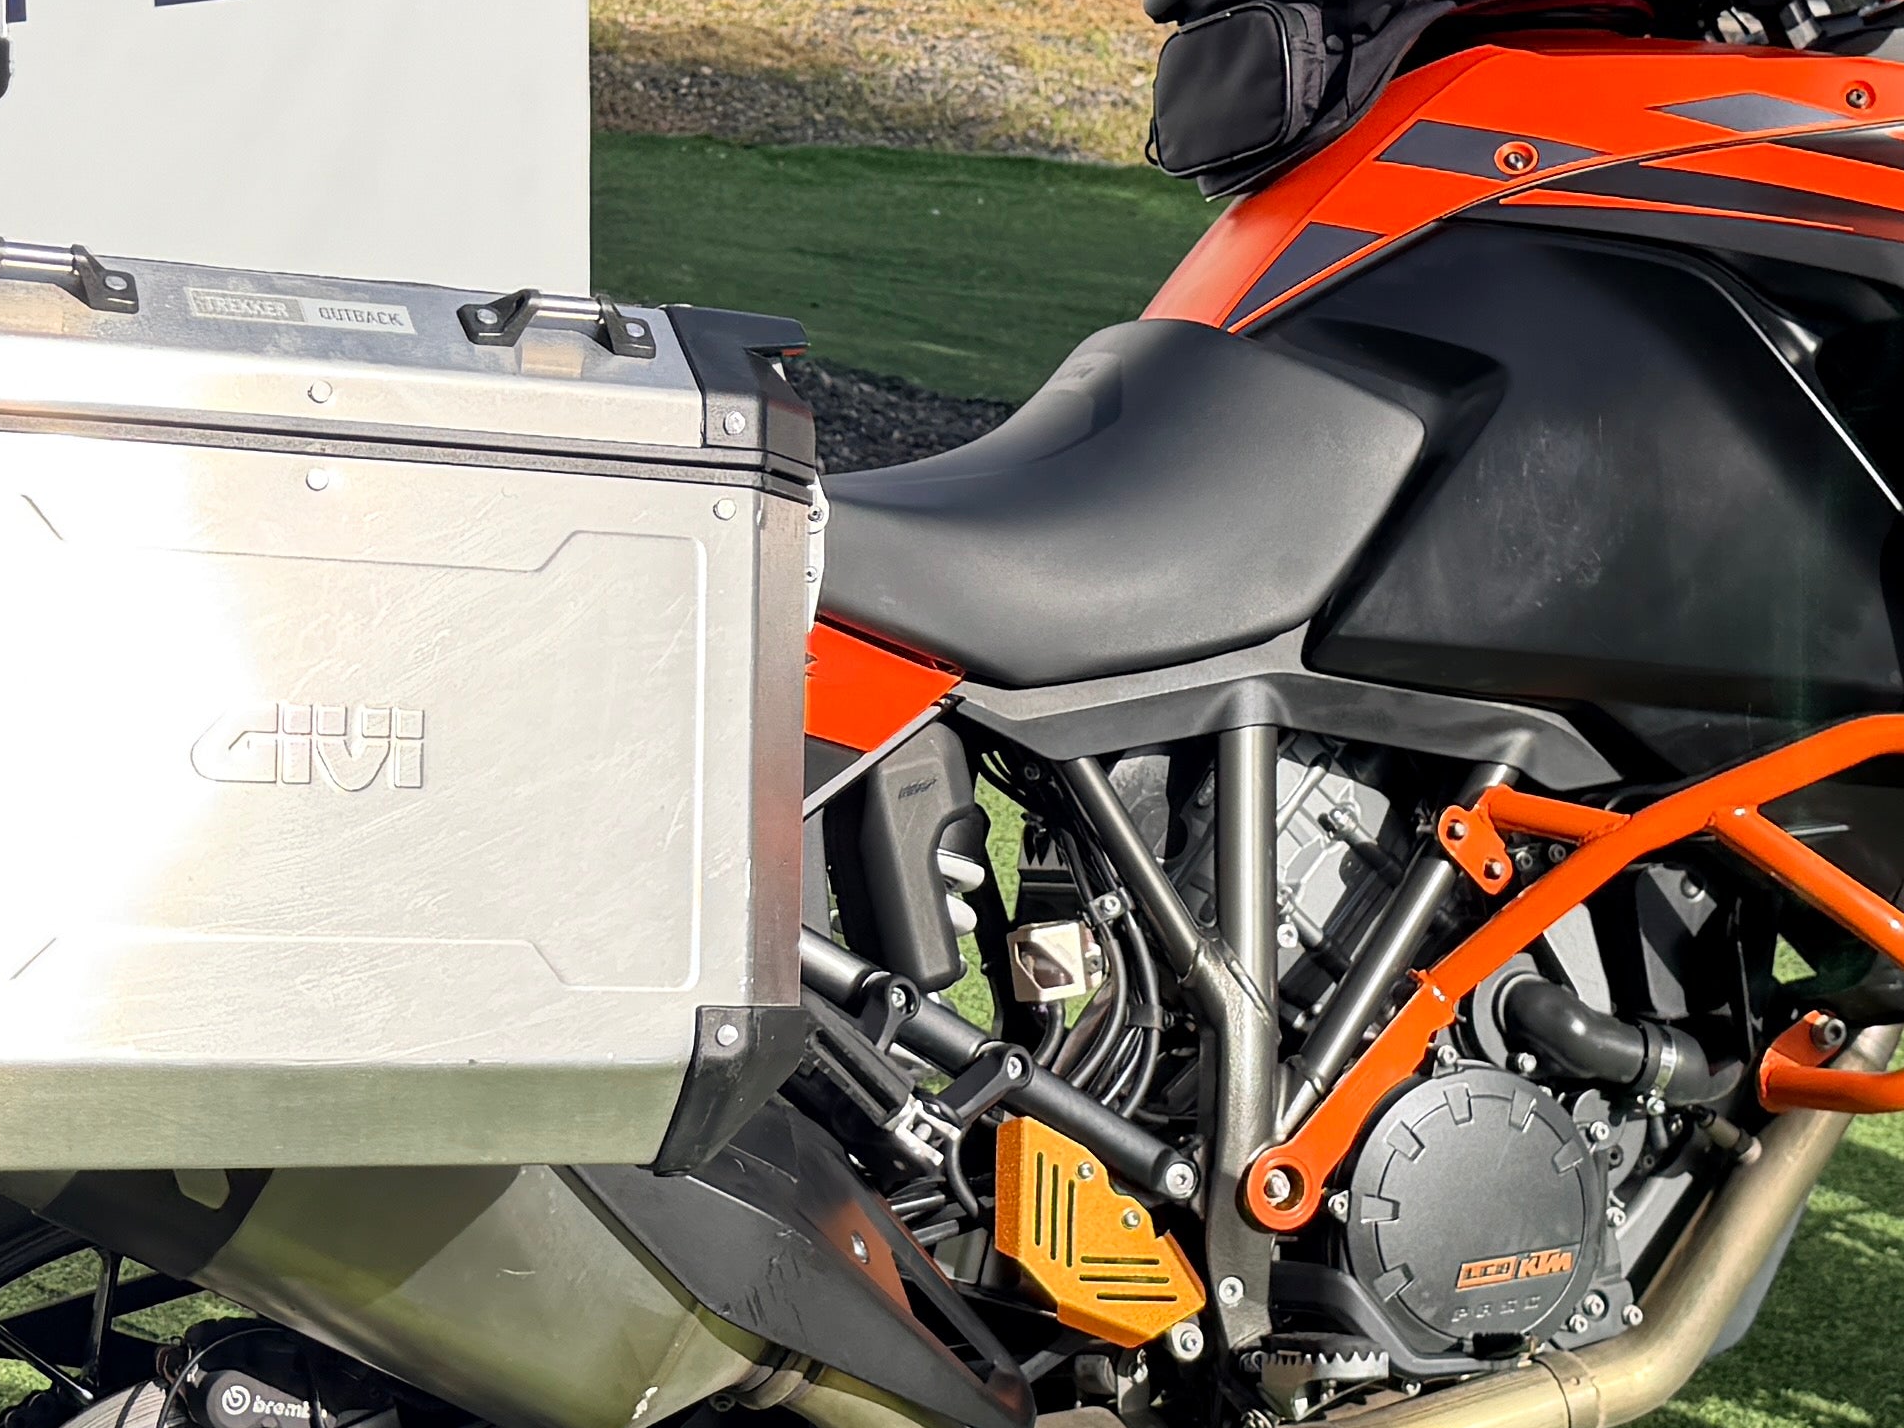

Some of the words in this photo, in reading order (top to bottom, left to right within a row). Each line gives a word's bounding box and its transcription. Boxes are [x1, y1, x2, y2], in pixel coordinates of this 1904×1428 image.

[204, 295, 289, 318] TREKKER
[318, 306, 404, 327] OUTBACK
[190, 703, 425, 792] GIVI
[1517, 1249, 1574, 1279] KTM
